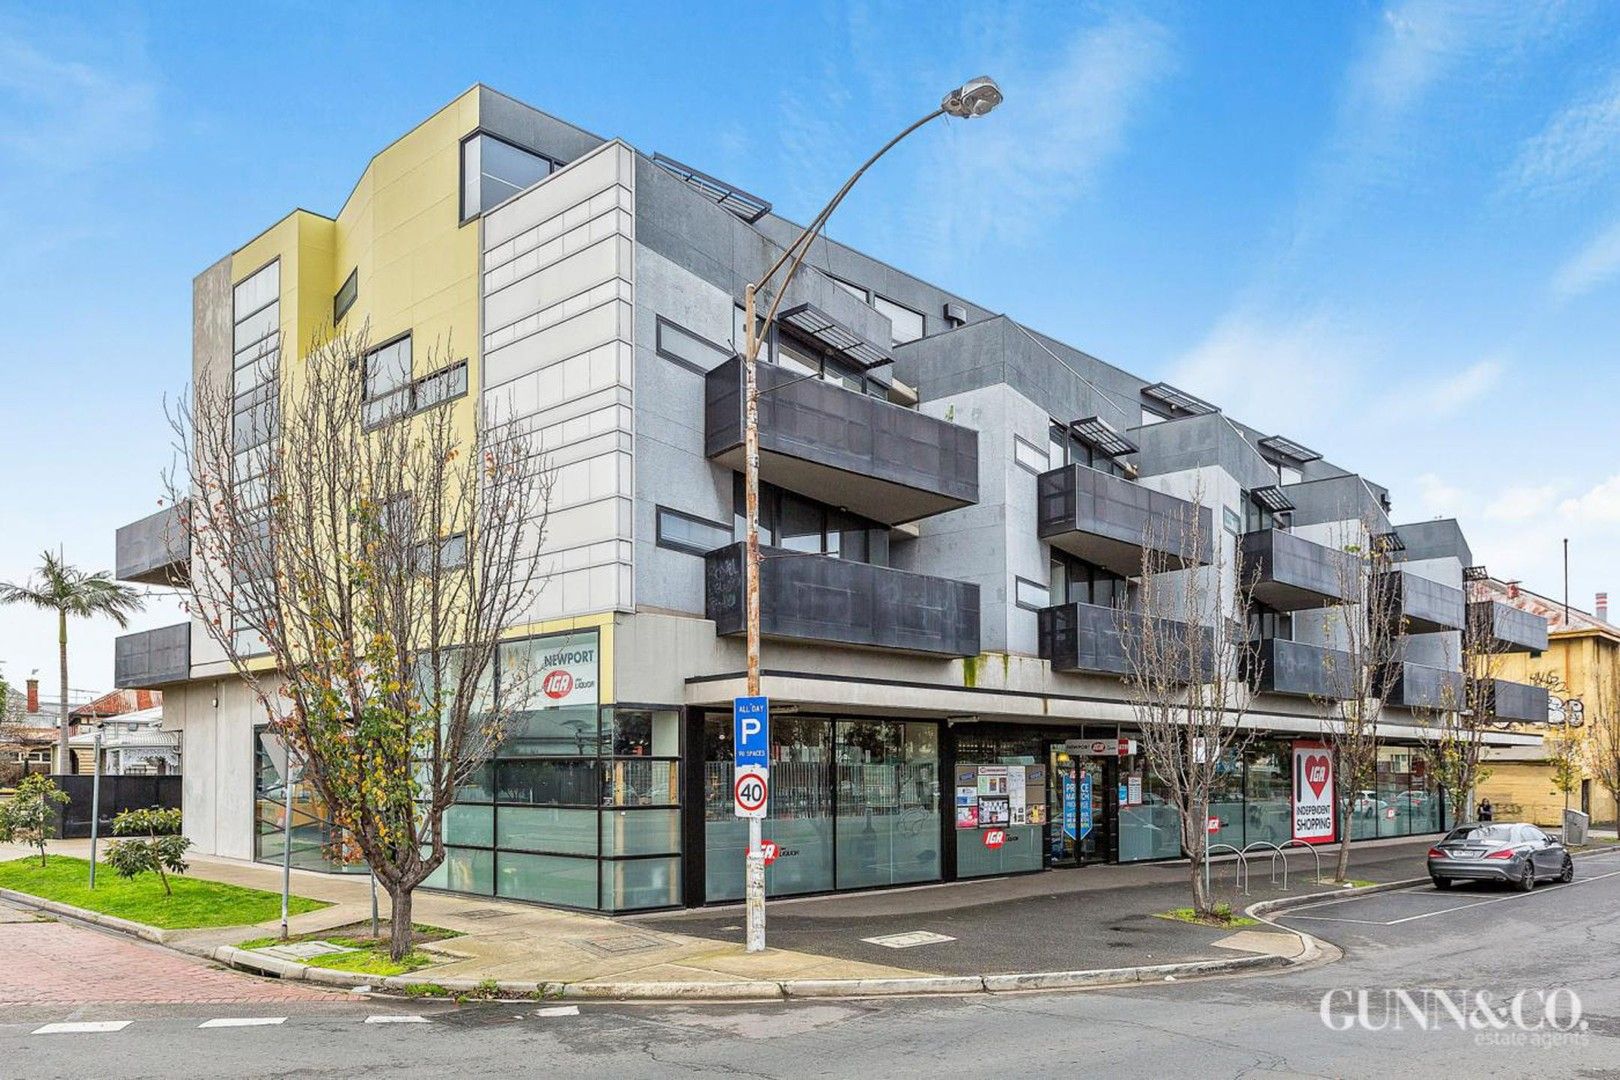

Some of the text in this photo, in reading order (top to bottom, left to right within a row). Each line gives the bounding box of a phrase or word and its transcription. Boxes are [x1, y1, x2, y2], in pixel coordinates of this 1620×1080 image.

[544, 650, 594, 667] NEWPORT
[546, 675, 569, 692] IGA
[739, 705, 750, 713] ALL
[741, 718, 761, 745] P
[1310, 766, 1325, 782] IGA
[741, 783, 762, 801] 40
[1297, 805, 1330, 815] INDEPENDENT
[1297, 817, 1330, 831] SHOPPING
[985, 831, 1004, 844] IGA
